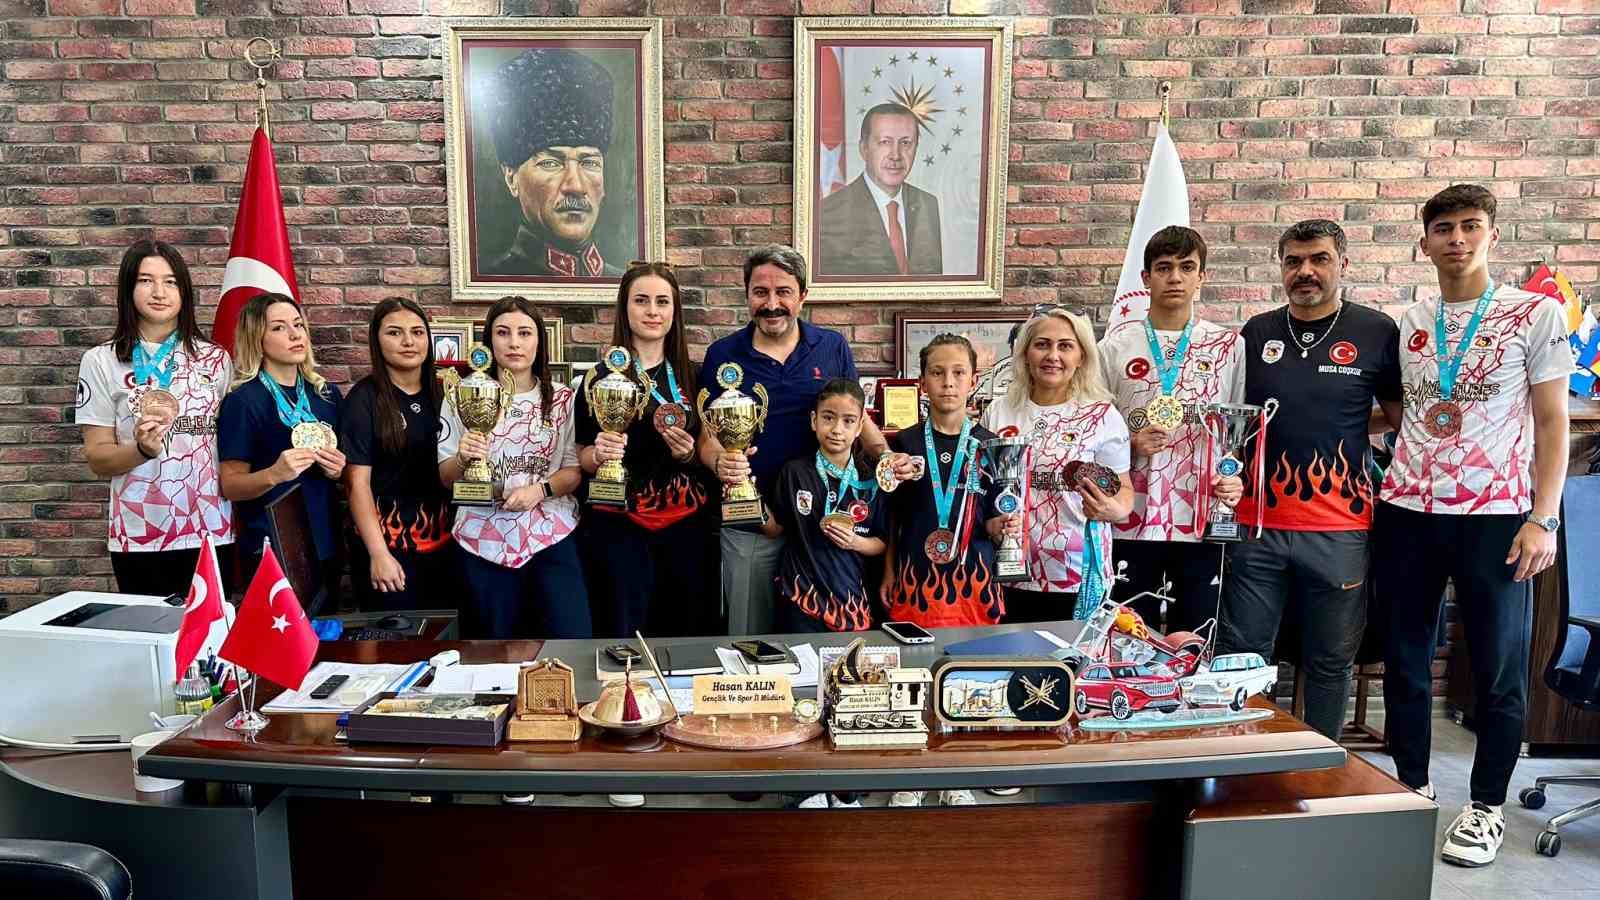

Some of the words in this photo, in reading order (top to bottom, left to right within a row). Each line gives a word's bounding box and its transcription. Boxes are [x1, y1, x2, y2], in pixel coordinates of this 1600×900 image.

[1318, 365, 1337, 374] MUSA
[712, 681, 743, 692] Hasan
[745, 681, 776, 691] KALIN
[728, 694, 736, 702] Ve
[737, 694, 752, 704] Spor
